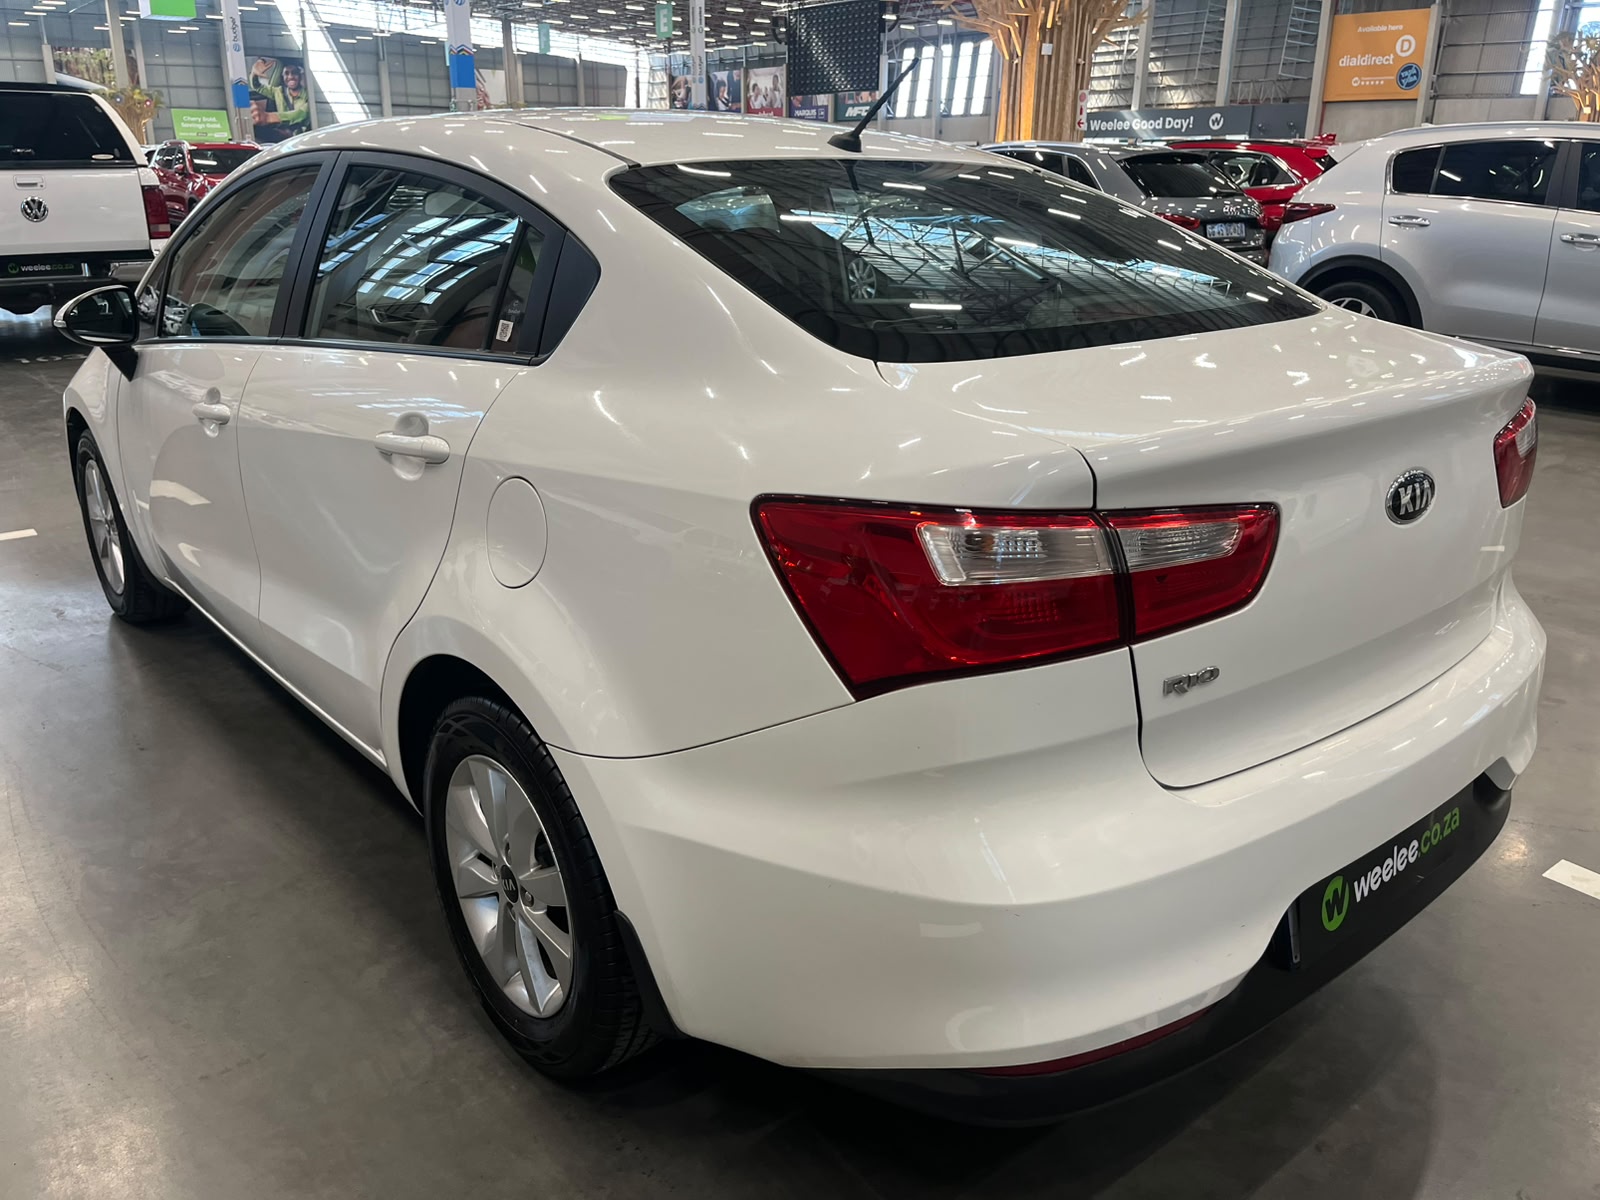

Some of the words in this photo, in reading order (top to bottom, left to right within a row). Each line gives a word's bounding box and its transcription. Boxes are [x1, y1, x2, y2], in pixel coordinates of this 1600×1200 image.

[660, 9, 669, 33] E
[1357, 25, 1387, 33] Available
[1339, 54, 1394, 67] dialdirect
[794, 109, 816, 117] MARQUIS
[1090, 119, 1130, 131] Weelee
[1132, 117, 1163, 130] Good
[1165, 116, 1194, 132] Day!
[1398, 479, 1432, 515] KIA
[1162, 666, 1220, 697] RIO
[1353, 807, 1460, 903] weelee.co.za
